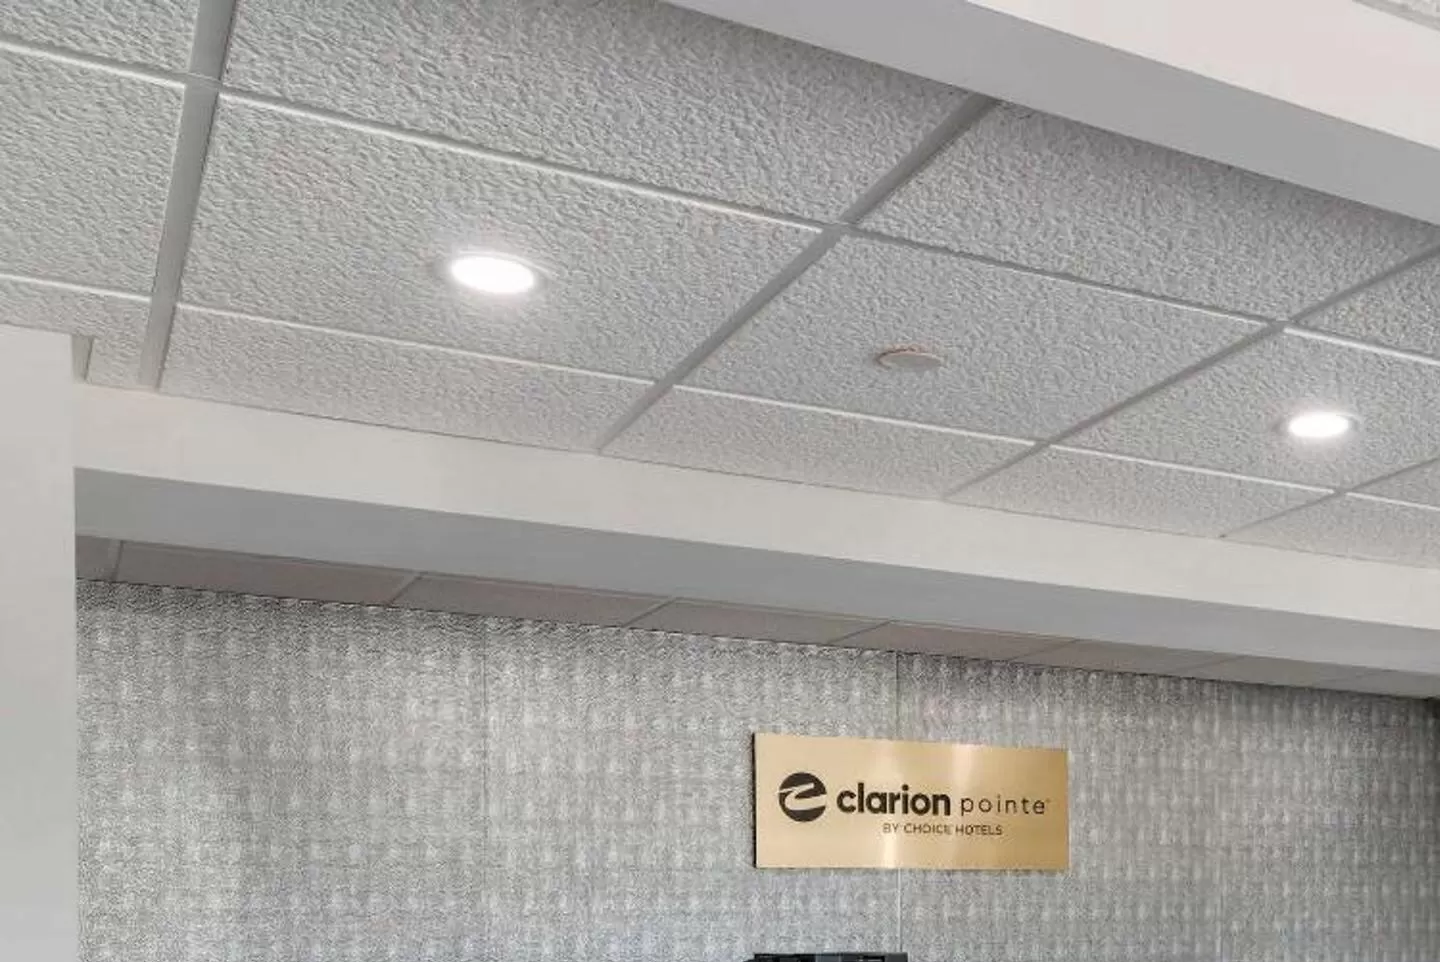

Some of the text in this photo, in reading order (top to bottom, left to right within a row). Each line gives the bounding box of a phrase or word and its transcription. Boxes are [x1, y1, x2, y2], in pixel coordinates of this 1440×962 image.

[837, 782, 1046, 816] clarion pointe
[882, 823, 1003, 836] BY CHOICE HOTELS
